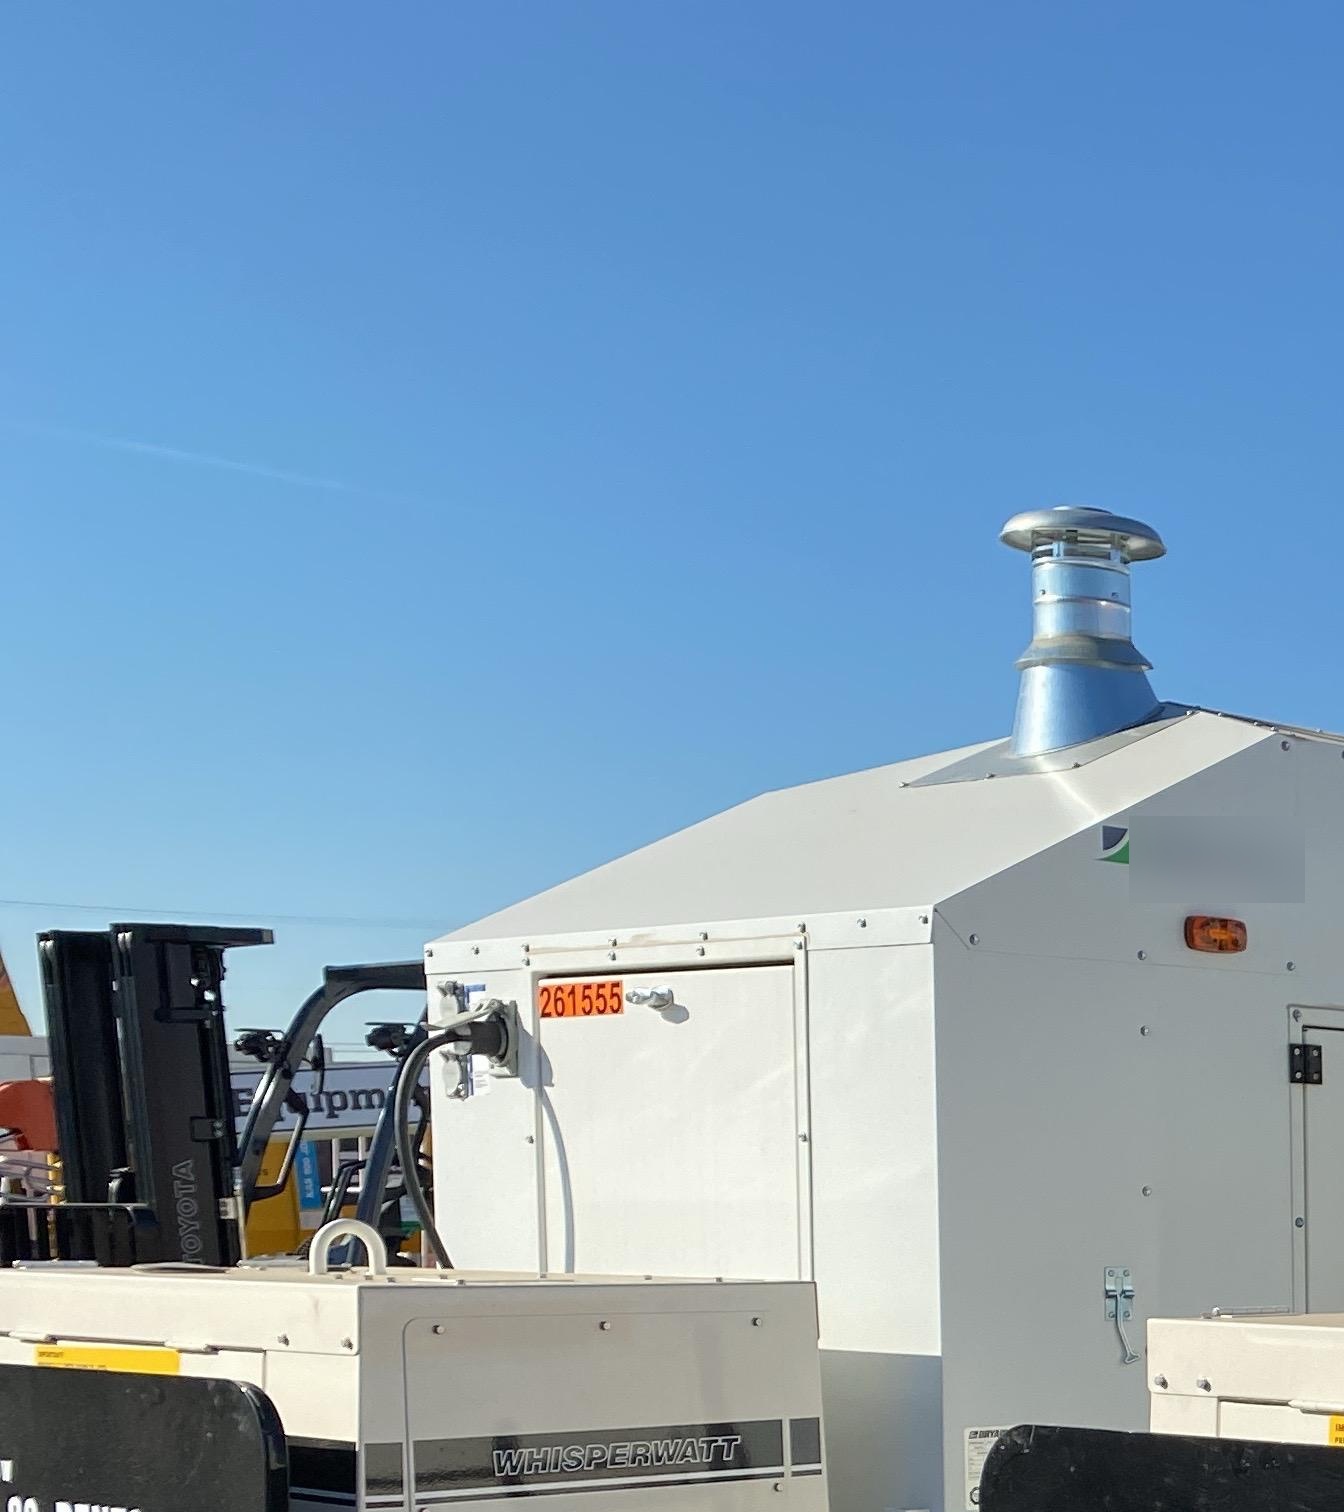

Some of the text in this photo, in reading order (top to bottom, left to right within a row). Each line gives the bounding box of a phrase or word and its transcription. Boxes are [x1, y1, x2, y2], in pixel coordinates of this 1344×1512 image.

[539, 981, 622, 1018] 261555
[171, 1158, 204, 1264] TOYOTA
[492, 1434, 742, 1477] WHISPERWATT
